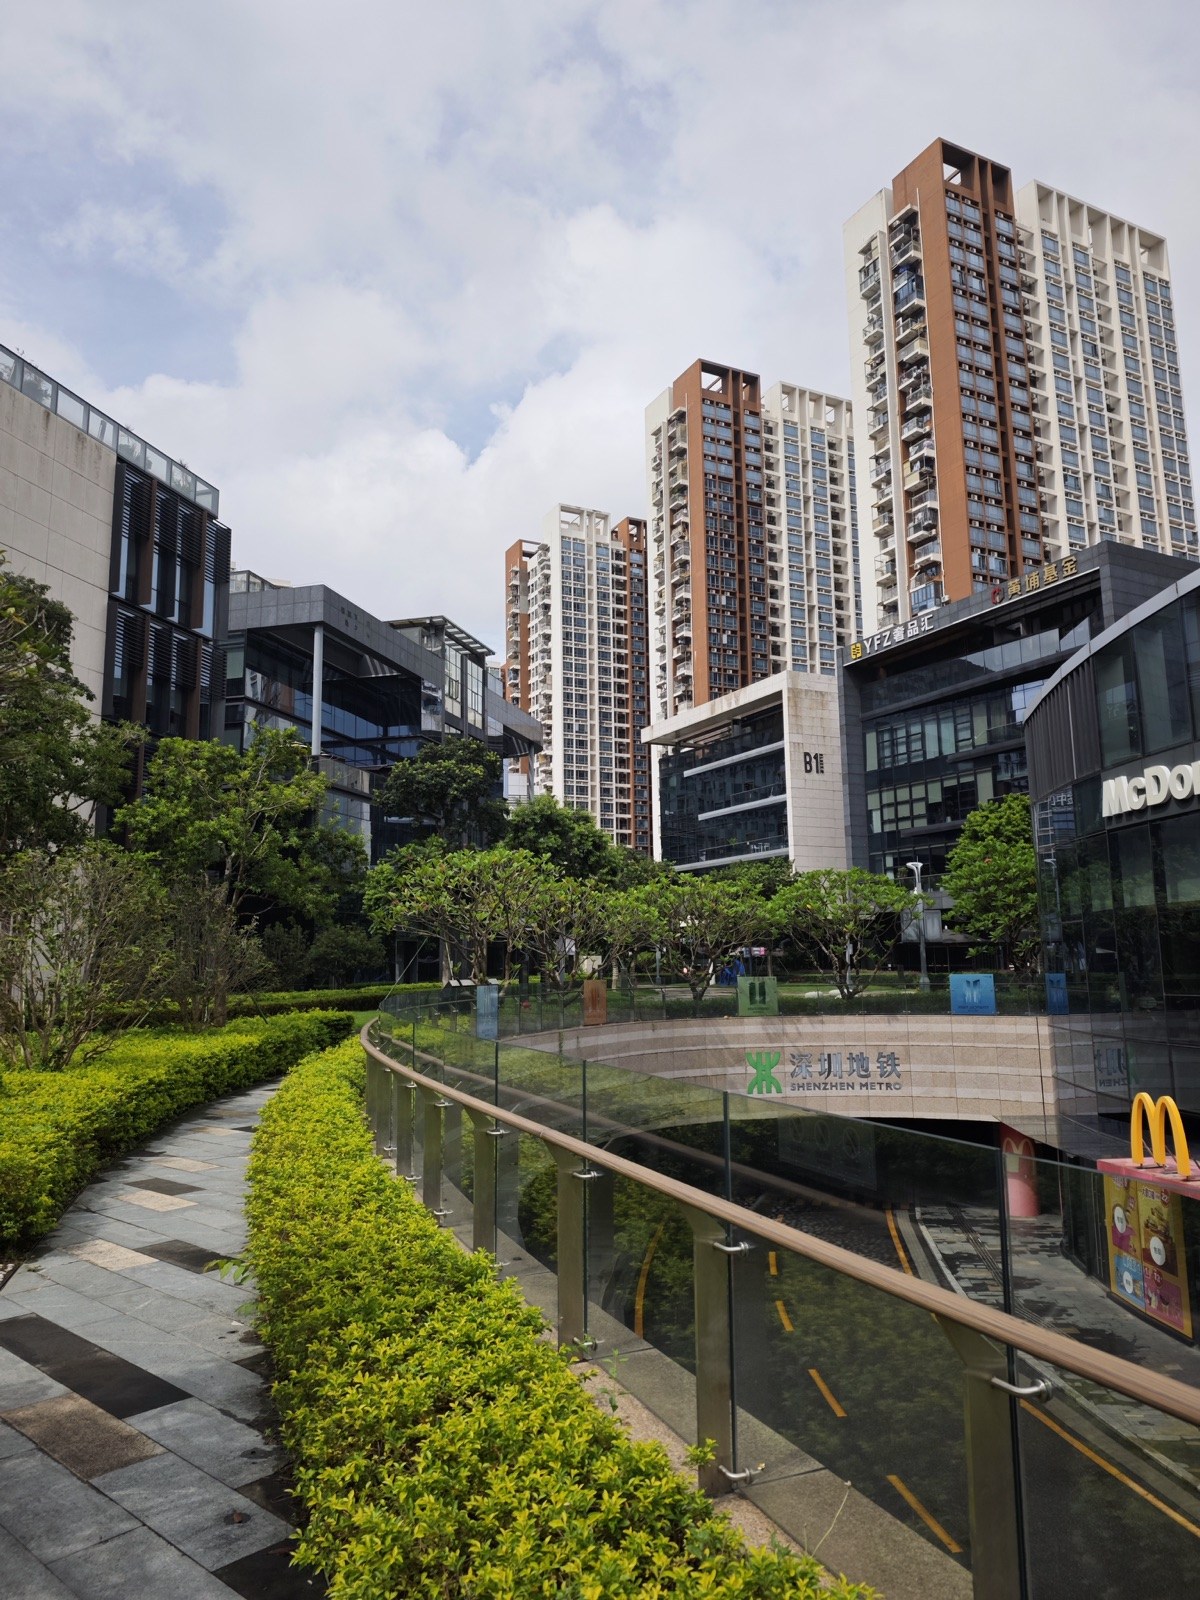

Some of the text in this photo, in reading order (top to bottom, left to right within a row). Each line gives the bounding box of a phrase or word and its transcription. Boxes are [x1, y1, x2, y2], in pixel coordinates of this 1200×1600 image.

[1008, 556, 1078, 598] 黄埔基金
[803, 751, 820, 774] B1
[789, 1051, 901, 1079] 深圳地铁
[790, 1082, 901, 1091] SHENZHEN METRO
